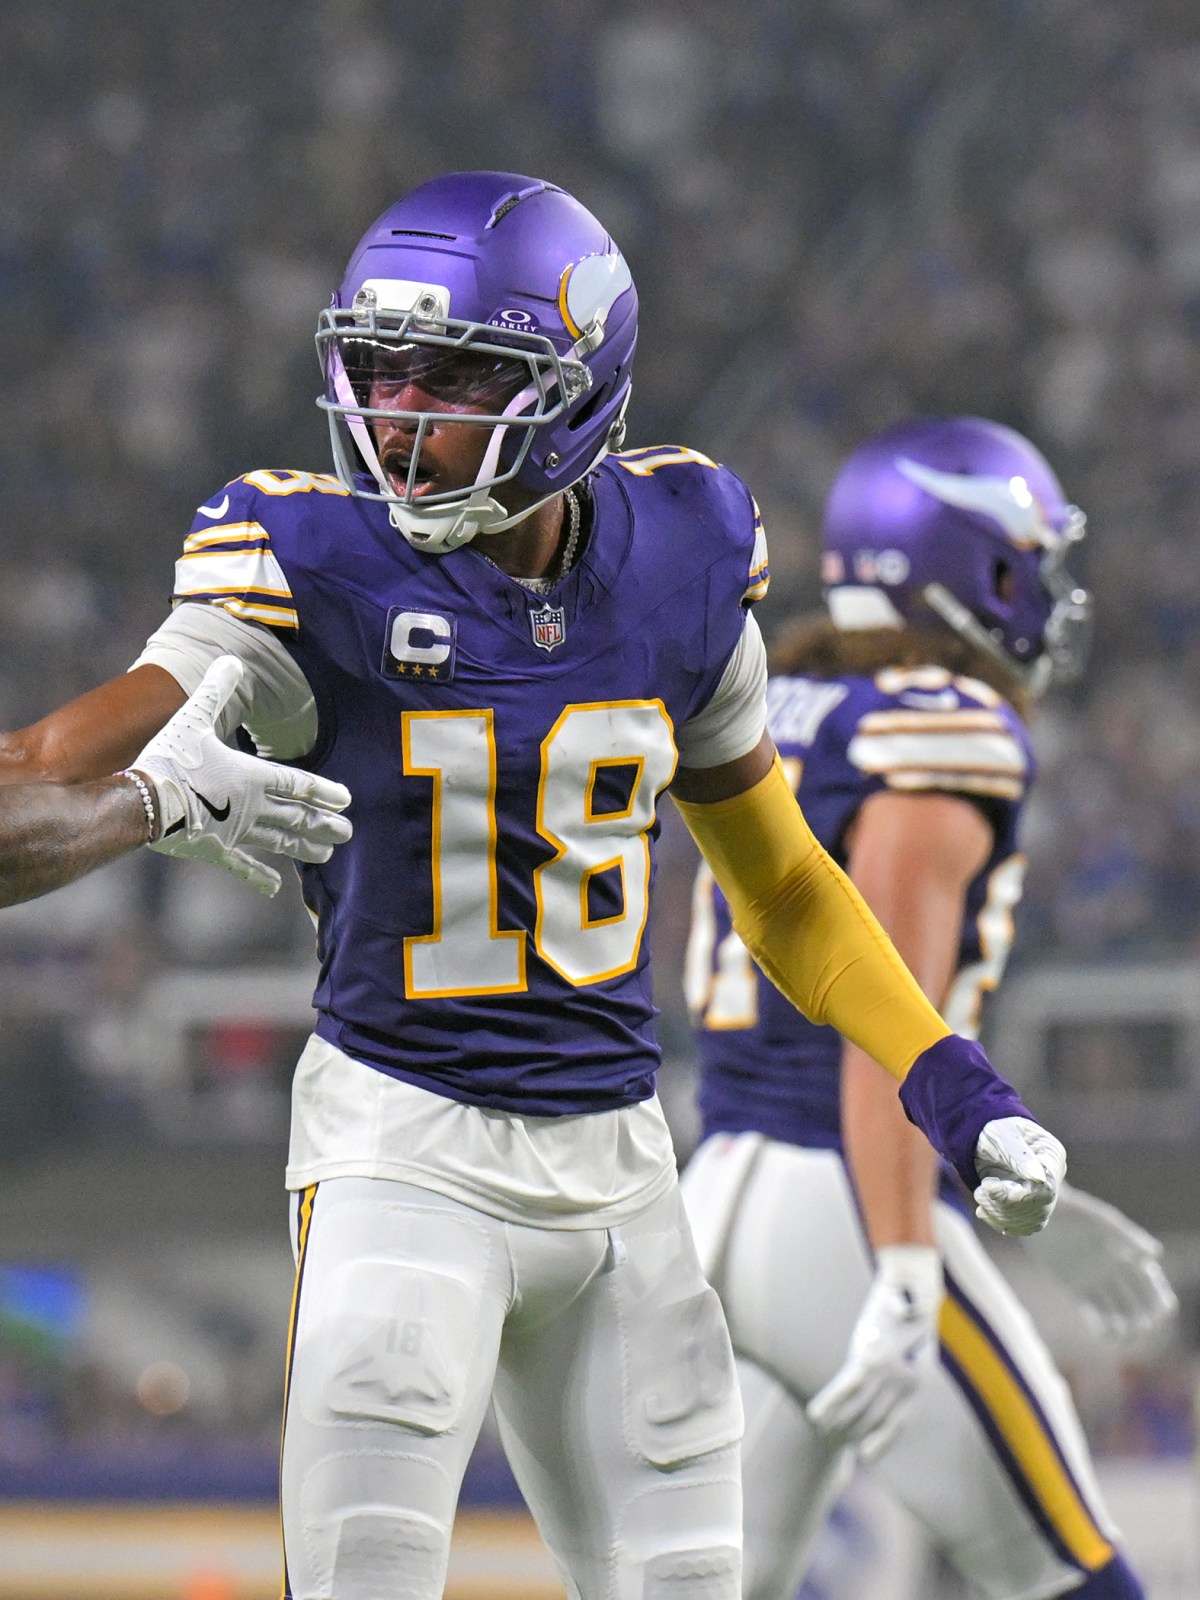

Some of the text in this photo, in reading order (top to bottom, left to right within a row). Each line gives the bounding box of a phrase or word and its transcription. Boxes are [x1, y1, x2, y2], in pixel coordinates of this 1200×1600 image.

[492, 320, 538, 332] OAKLEY
[391, 612, 450, 664] C
[537, 625, 560, 642] NFL
[401, 698, 678, 999] 18
